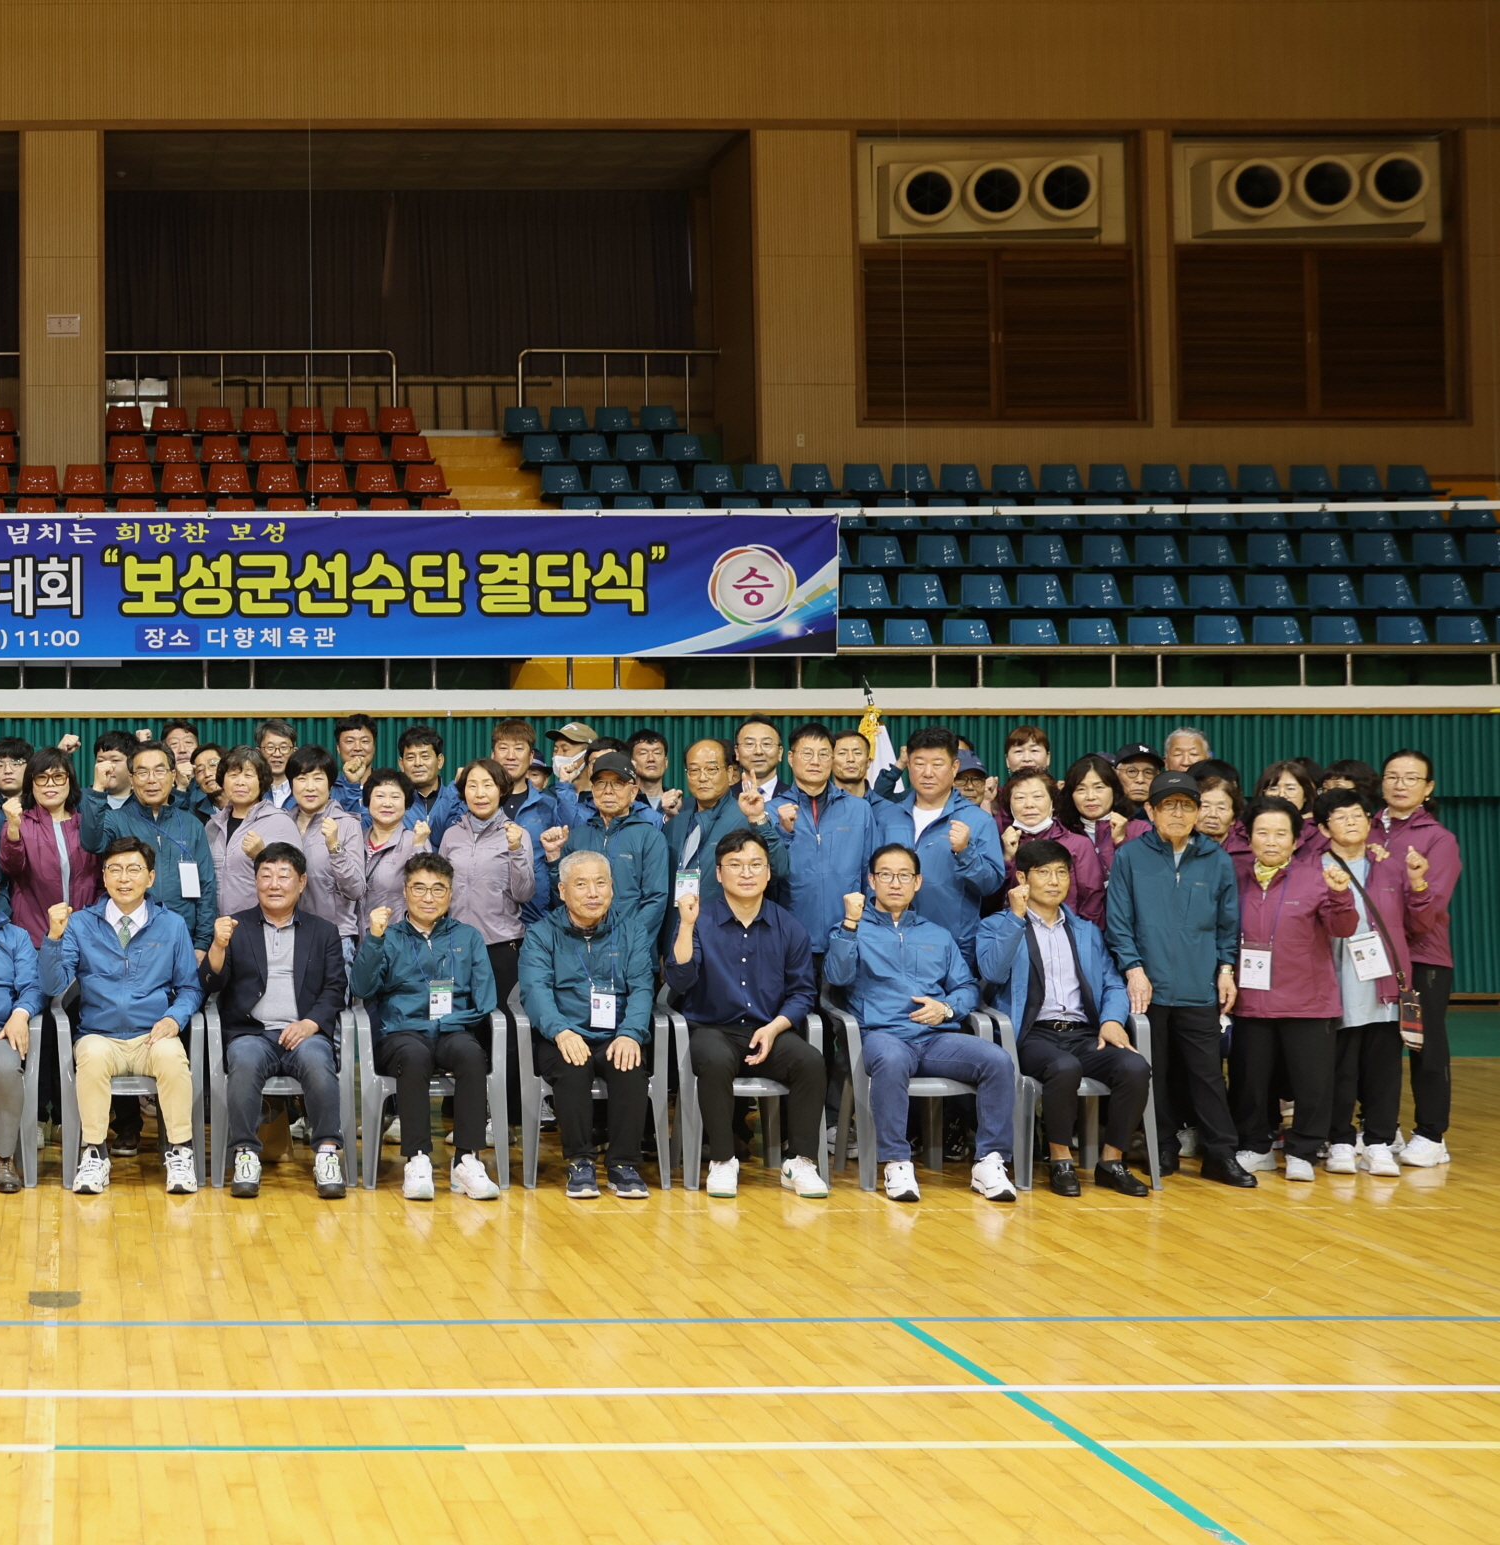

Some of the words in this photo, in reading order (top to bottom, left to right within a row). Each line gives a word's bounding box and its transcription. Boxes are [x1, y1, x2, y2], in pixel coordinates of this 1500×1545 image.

[7, 522, 97, 546] 넘치는
[115, 522, 210, 545] 희망찬
[227, 522, 287, 544] 보성
[732, 566, 774, 606] 승
[14, 630, 80, 647] 11:00
[144, 628, 191, 649] 장소
[206, 627, 337, 648] 다향체육관
